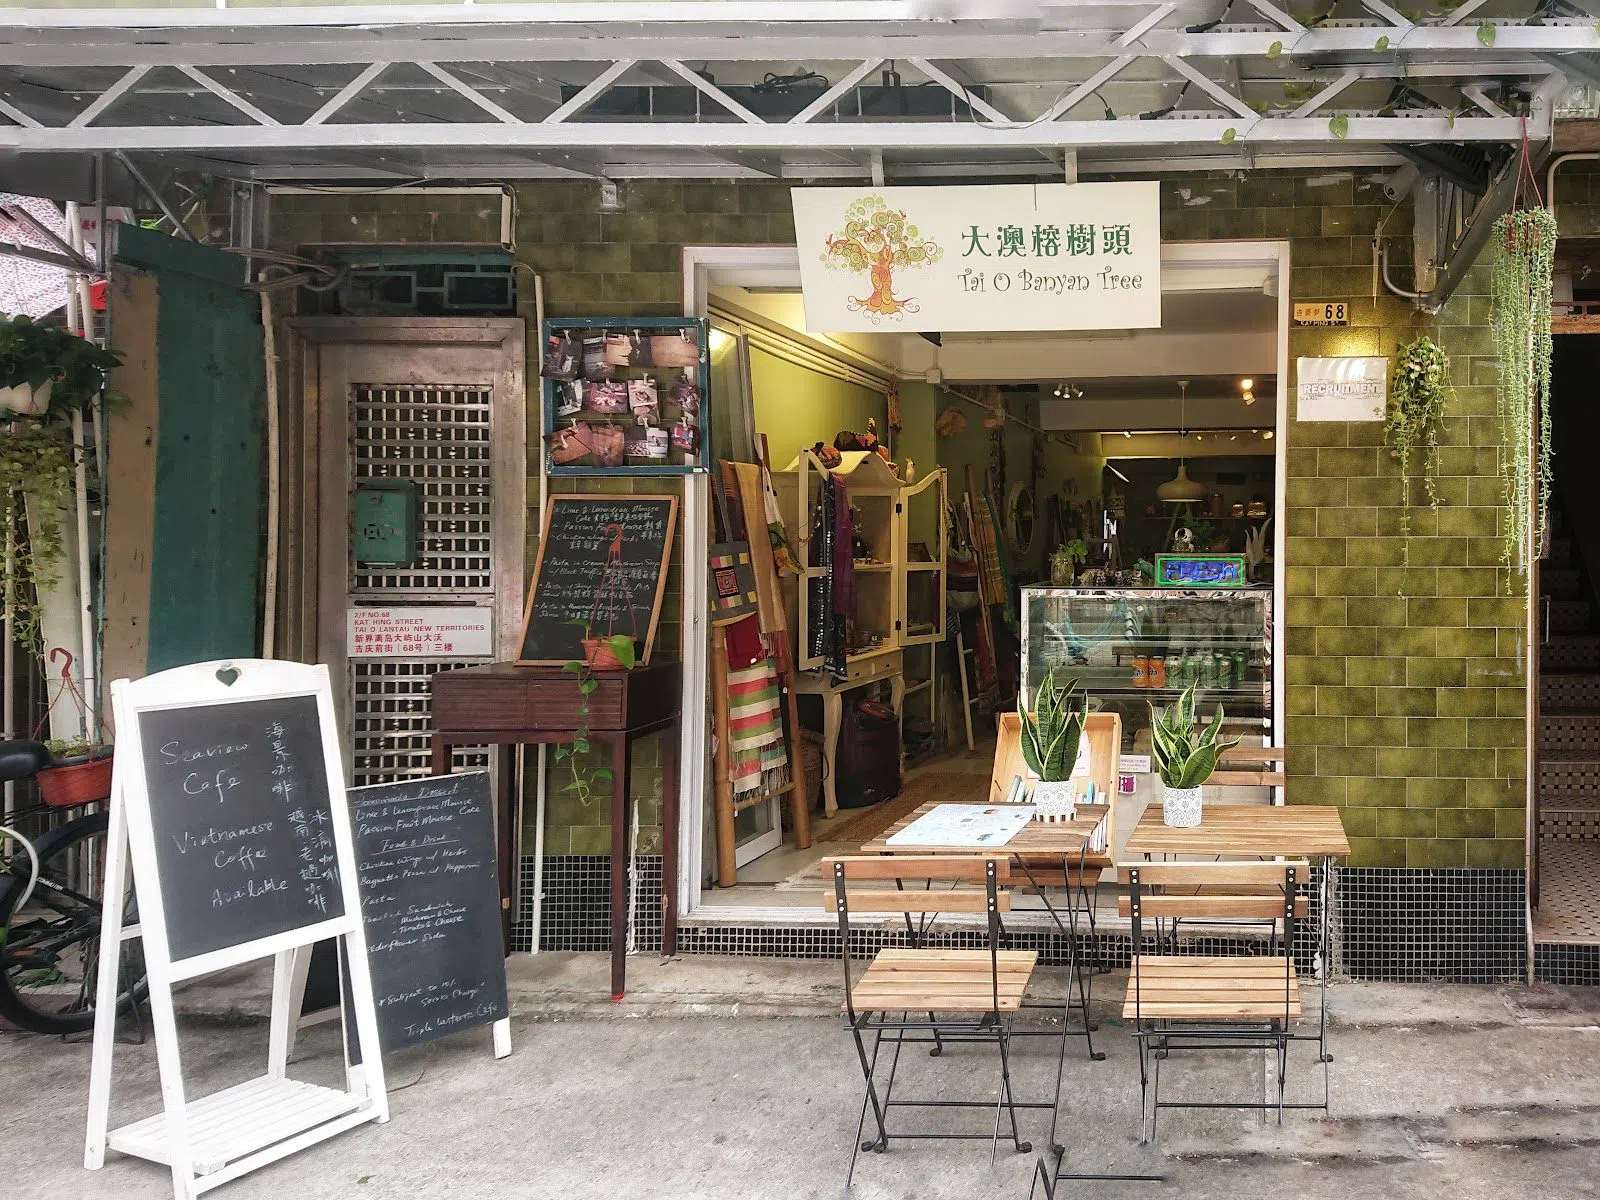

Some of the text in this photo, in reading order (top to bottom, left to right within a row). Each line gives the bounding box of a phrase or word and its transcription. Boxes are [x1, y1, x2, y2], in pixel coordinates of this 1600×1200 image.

[961, 223, 1133, 258] 大澳榕樹頭
[957, 266, 1143, 296] Tai O Banyan Tree
[1325, 304, 1344, 320] 68
[1303, 383, 1381, 394] RECRUITMENT
[1165, 561, 1237, 582] FRESH
[160, 741, 248, 765] Seaview
[183, 769, 241, 803] Cafe
[173, 821, 273, 854] Vietnamese
[211, 878, 289, 909] Available
